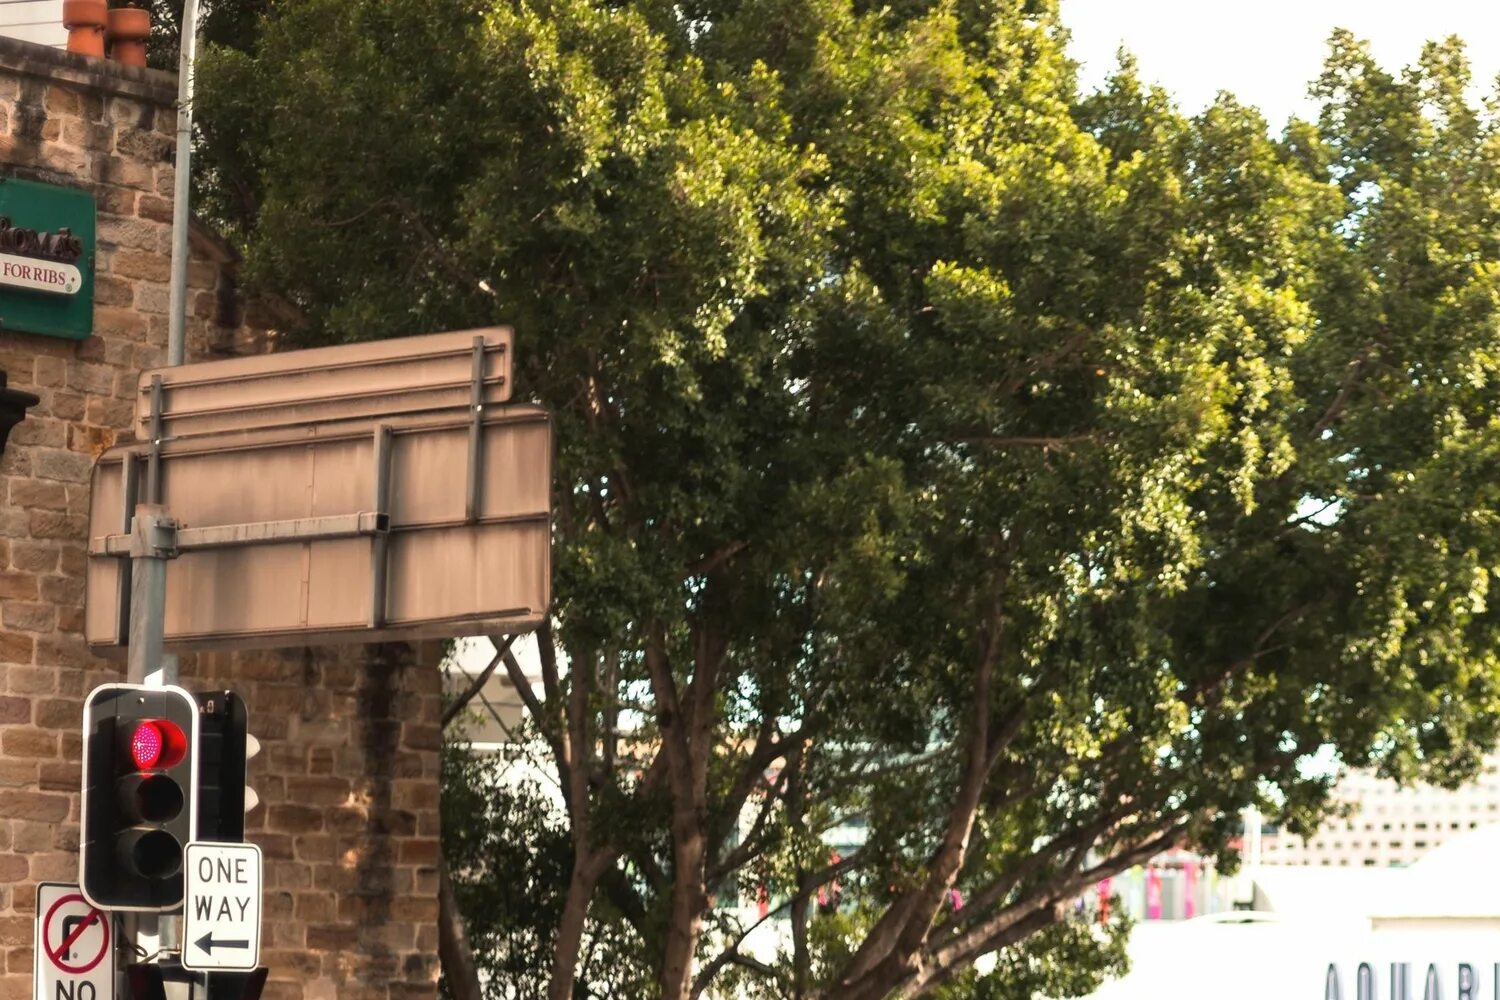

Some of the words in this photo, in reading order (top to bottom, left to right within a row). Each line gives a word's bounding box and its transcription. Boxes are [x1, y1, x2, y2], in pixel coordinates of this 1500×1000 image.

[3, 262, 31, 279] FOR
[33, 267, 66, 285] RIBS
[198, 856, 248, 884] ONE
[194, 896, 251, 922] WAY
